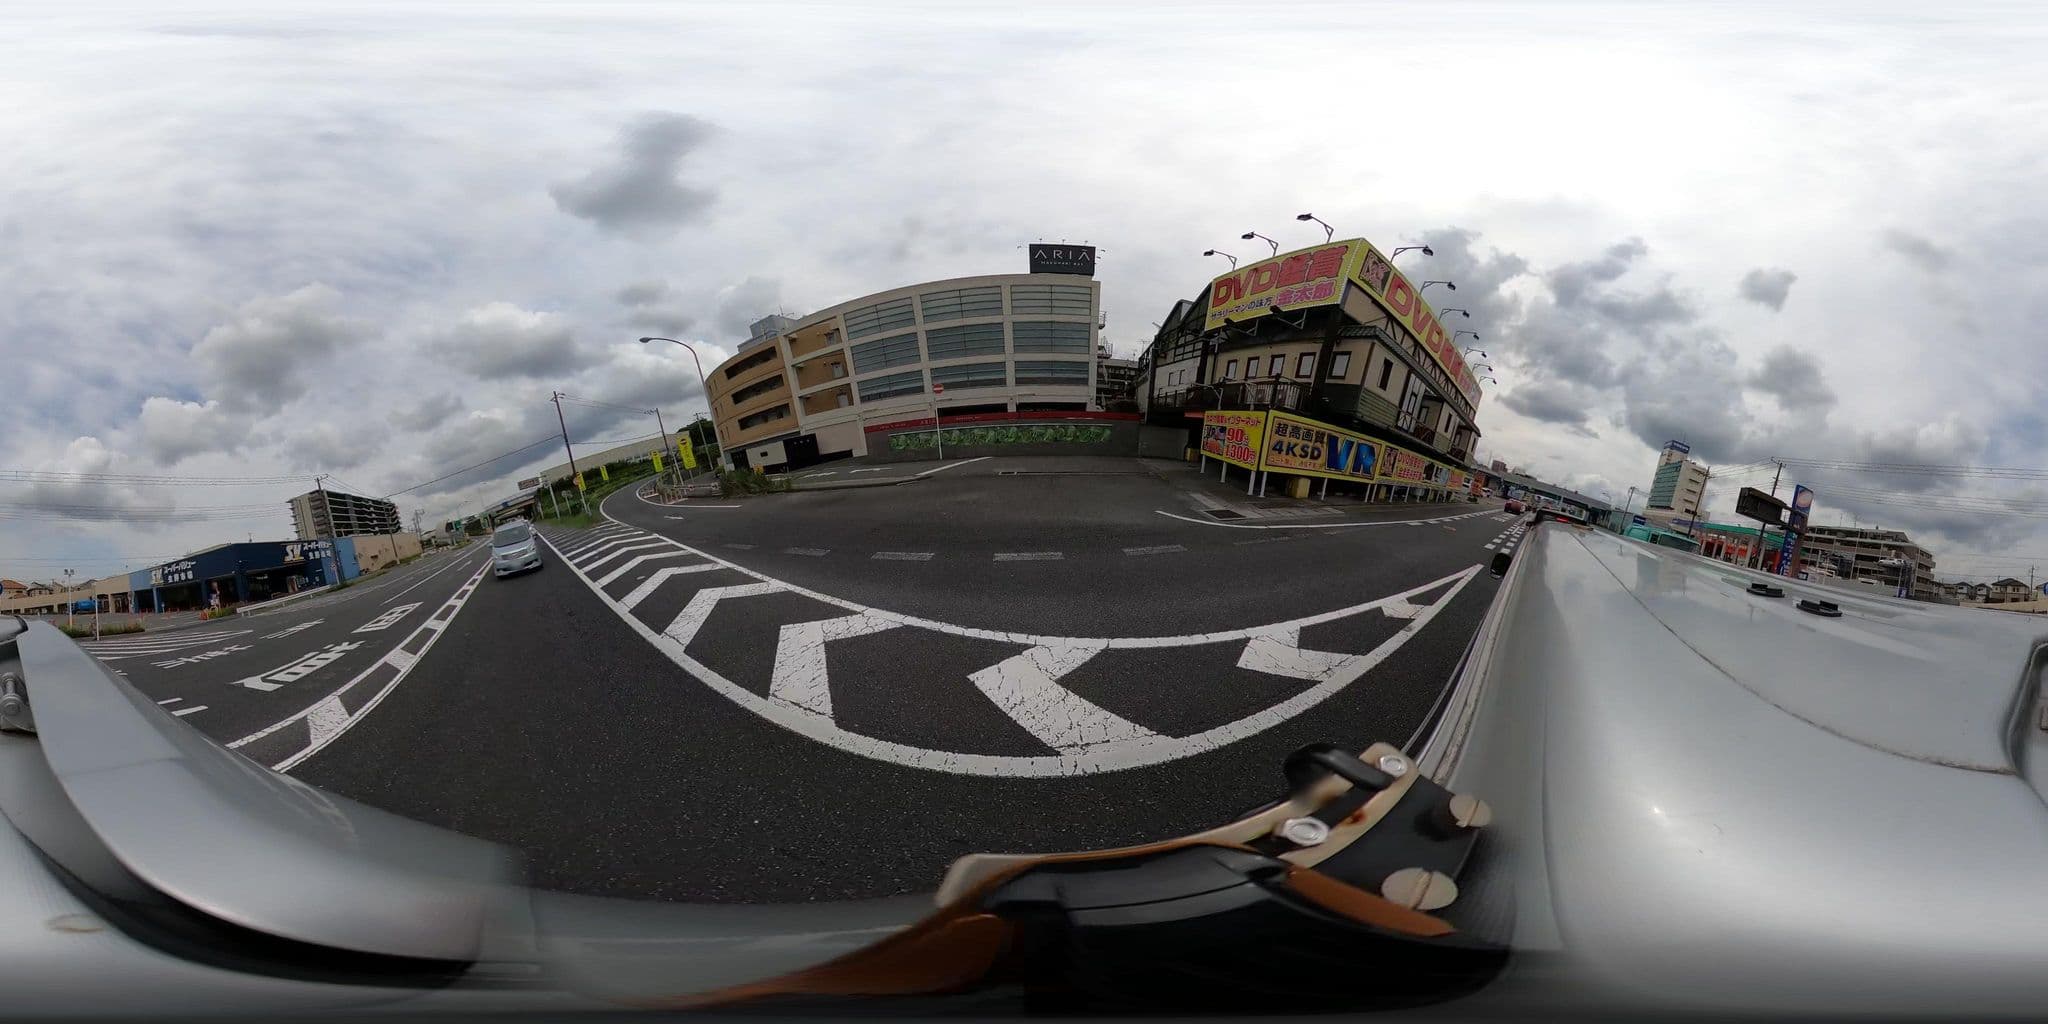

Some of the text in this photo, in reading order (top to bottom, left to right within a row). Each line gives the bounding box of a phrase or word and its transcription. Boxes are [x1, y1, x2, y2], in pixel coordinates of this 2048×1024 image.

[1212, 245, 1348, 308] DVD鑑賞
[1275, 423, 1325, 444] 超高画質
[1326, 433, 1376, 476] VR
